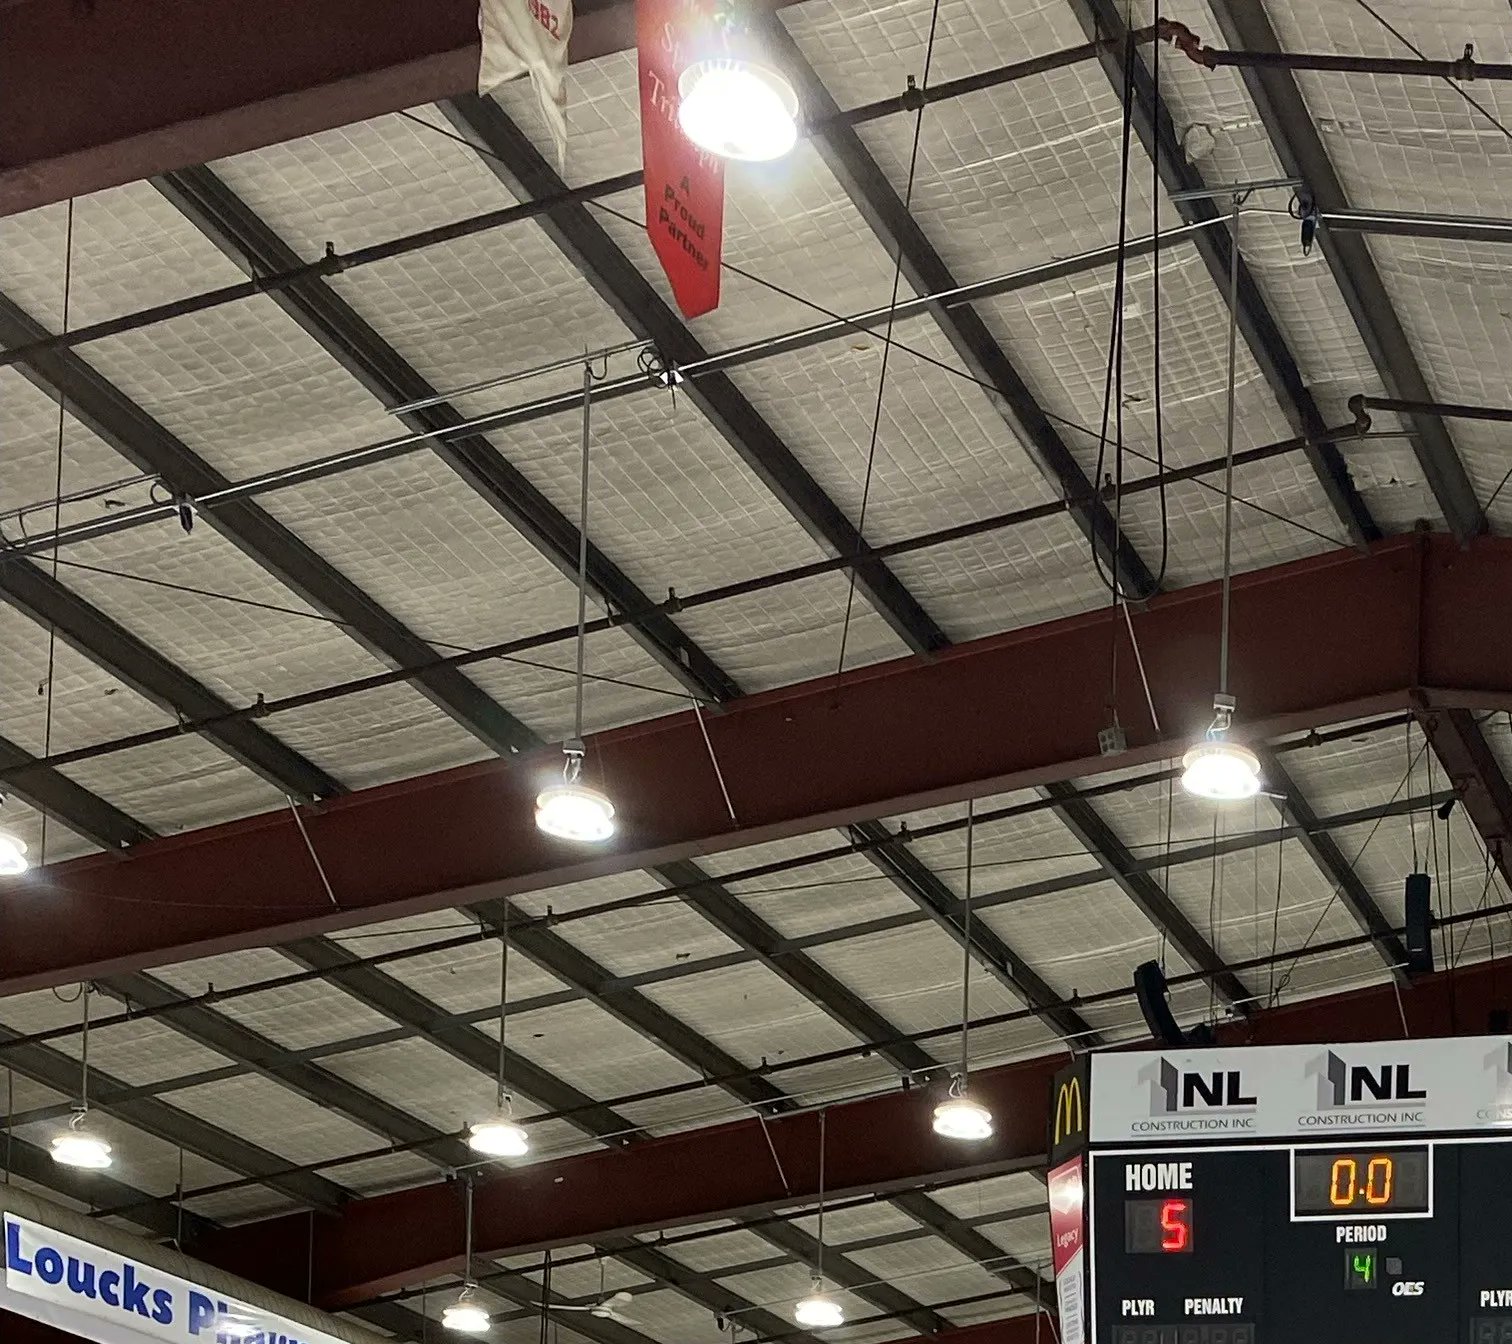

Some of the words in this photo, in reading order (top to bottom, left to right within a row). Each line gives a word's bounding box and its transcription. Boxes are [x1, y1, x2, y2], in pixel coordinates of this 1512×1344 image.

[664, 183, 706, 241] Proud
[1131, 1119, 1229, 1133] CONSTRUCTION
[1298, 1113, 1396, 1126] CONSTRUCTION
[1125, 1162, 1193, 1191] HOME
[1330, 1157, 1394, 1206] 0.0
[1056, 1227, 1080, 1249] Legacy
[1160, 1199, 1188, 1252] 5
[1336, 1225, 1388, 1244] PERIOD
[6, 1222, 173, 1325] Loucks
[1352, 1251, 1372, 1283] 4
[1392, 1281, 1425, 1297] OES
[1122, 1299, 1155, 1317] PLYR
[1184, 1297, 1243, 1316] PENALTY
